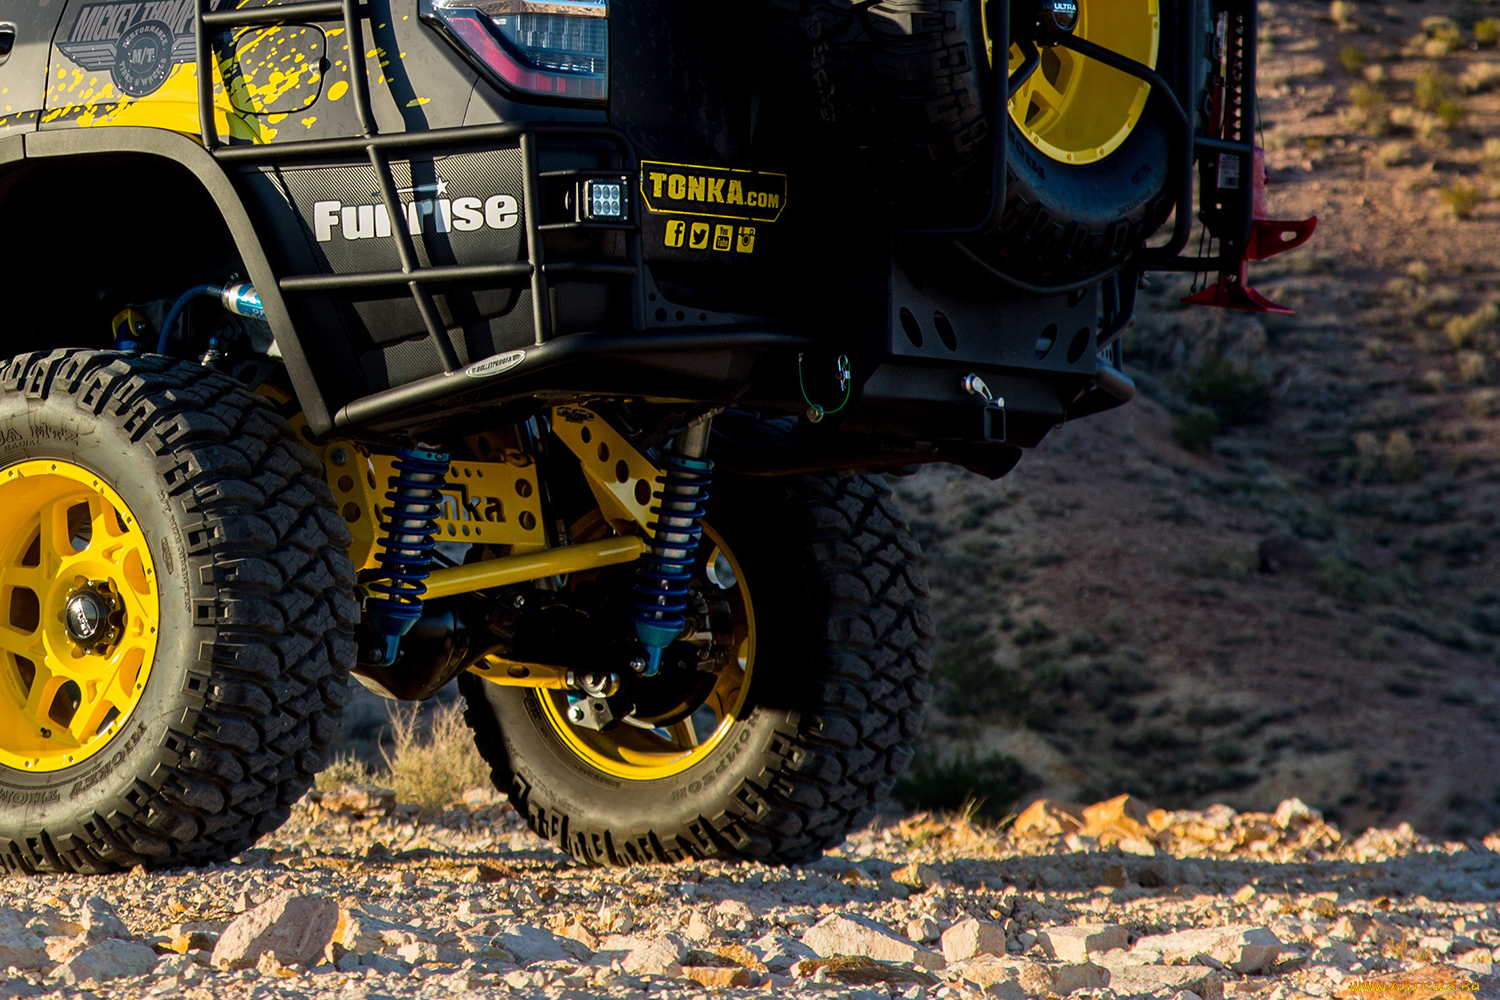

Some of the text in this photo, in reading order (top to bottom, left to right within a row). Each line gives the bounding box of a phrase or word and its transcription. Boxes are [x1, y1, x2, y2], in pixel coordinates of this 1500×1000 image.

[70, 2, 141, 42] MICKEY
[1054, 2, 1077, 11] ULTRA
[122, 25, 168, 49] PERFORMANCE
[132, 46, 155, 66] M/T
[649, 170, 780, 209] TONKA.COM
[439, 483, 506, 522] nka
